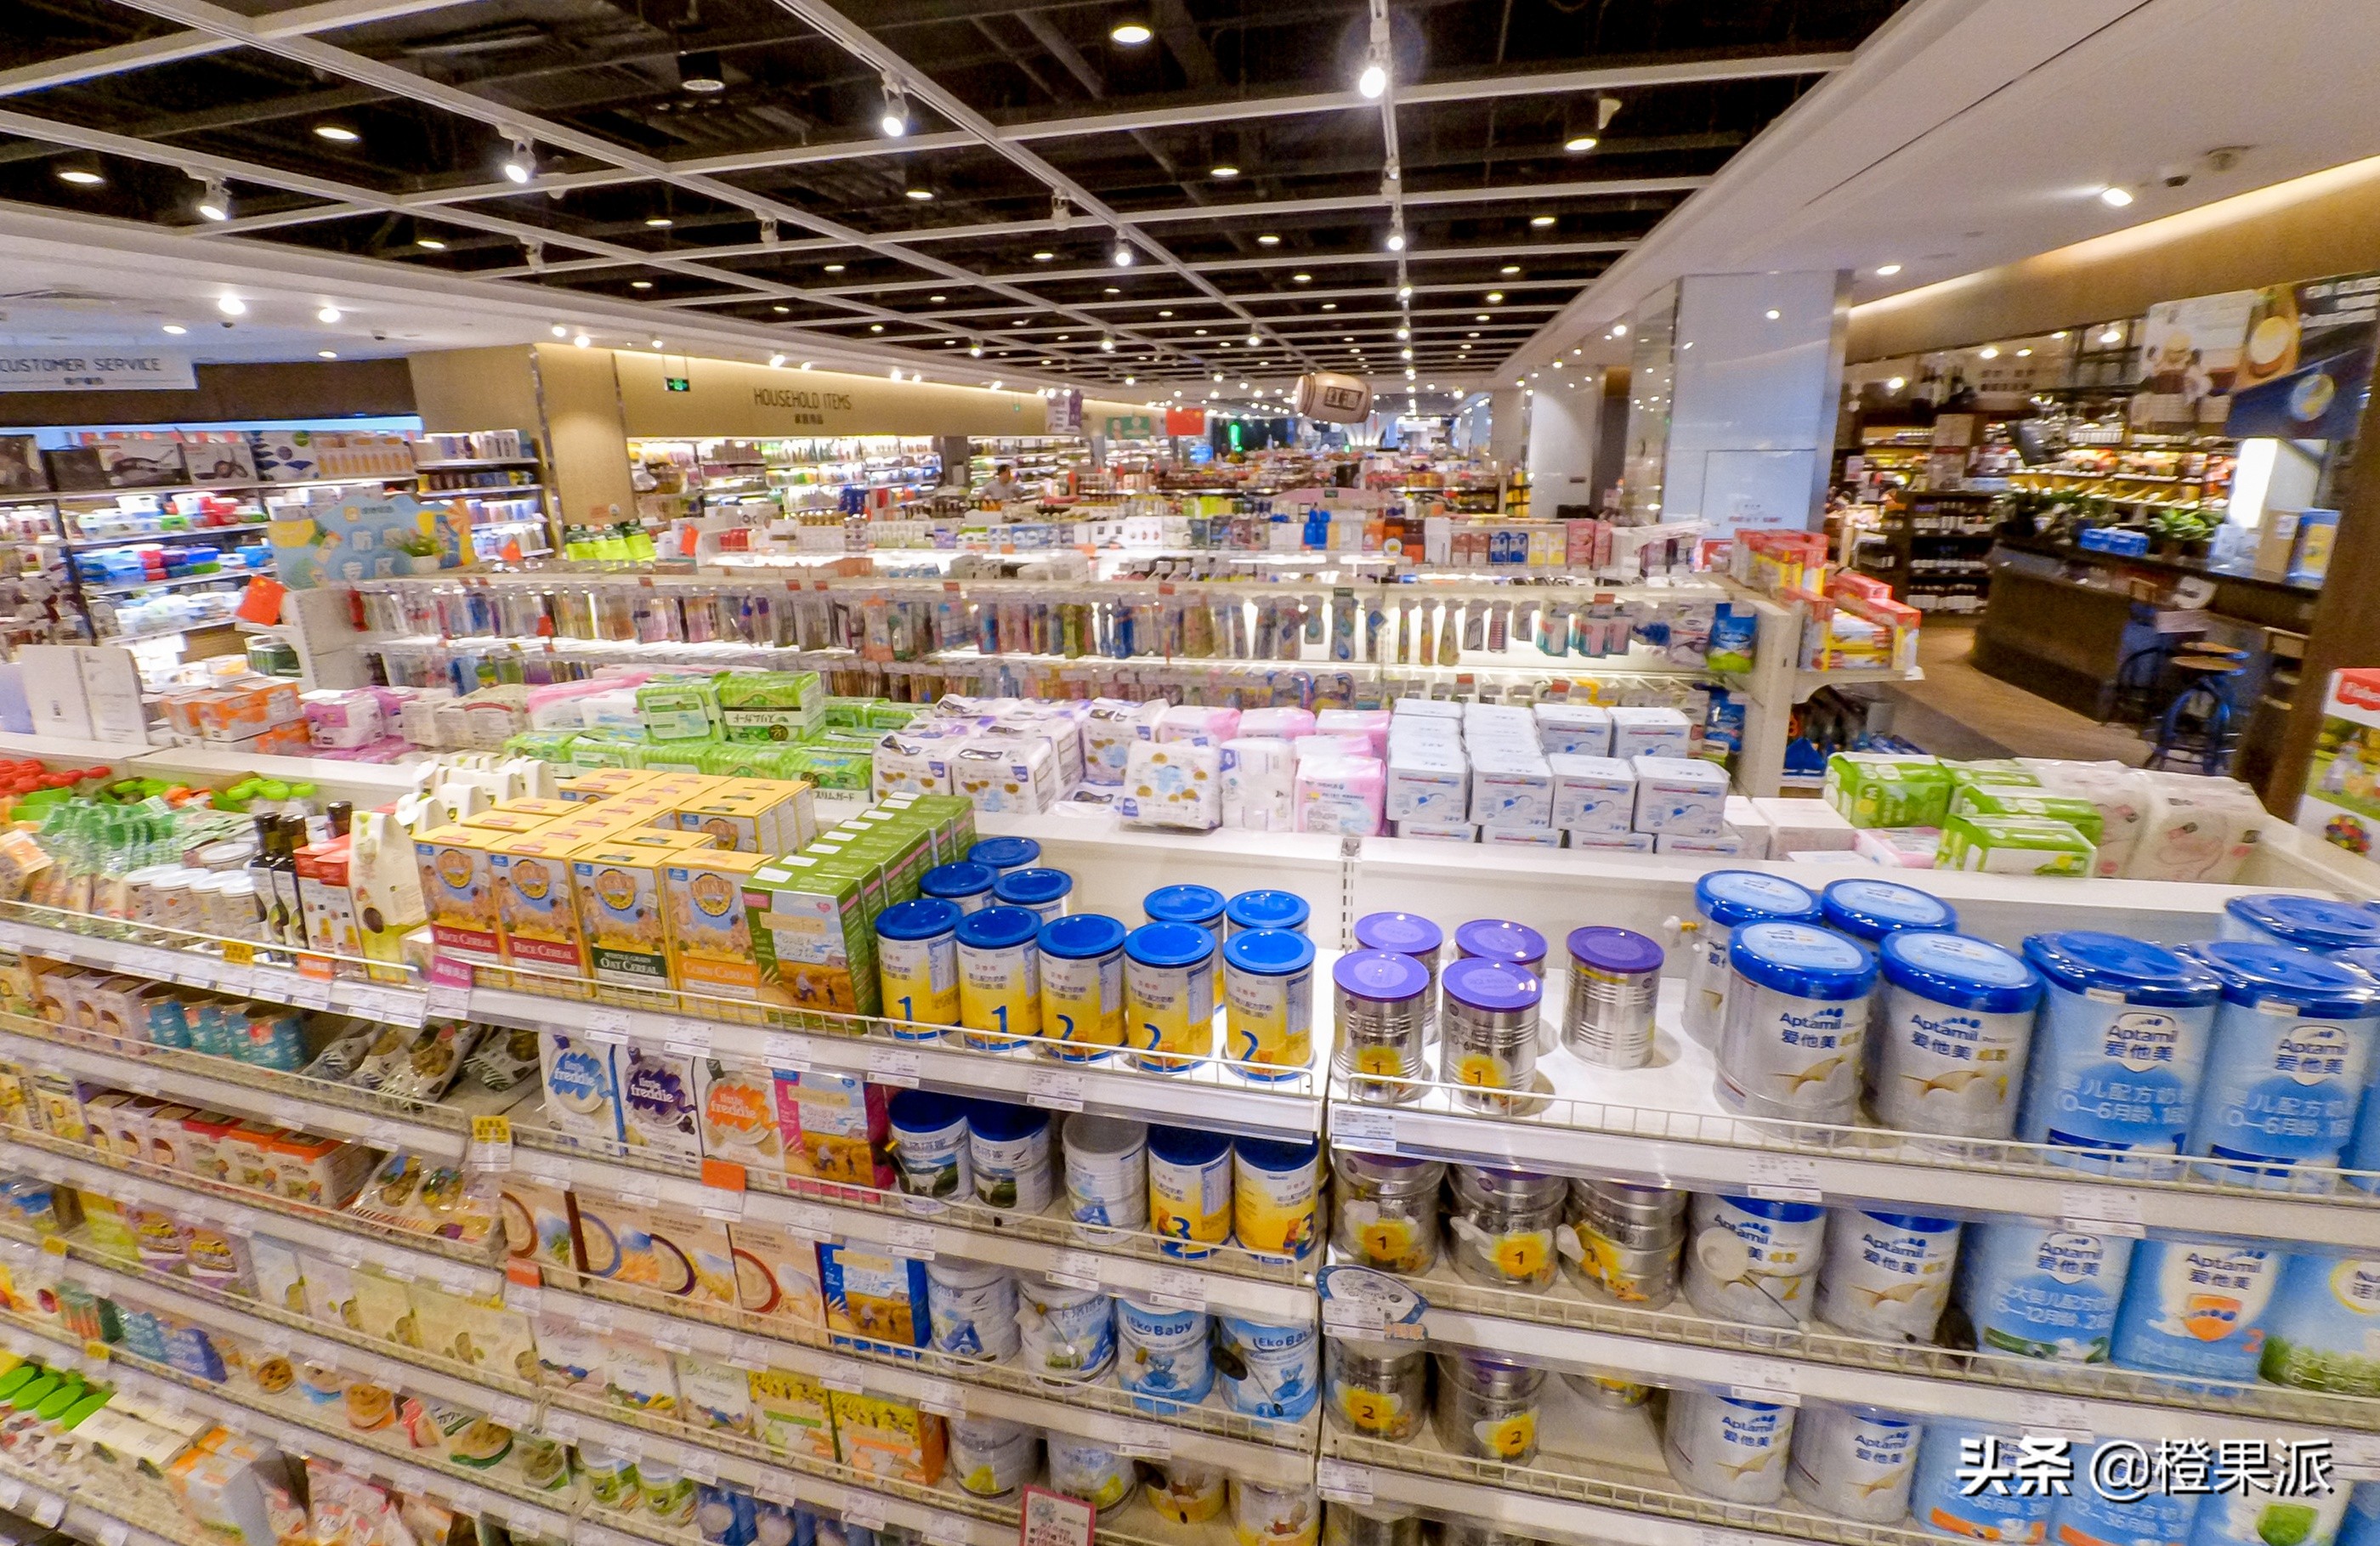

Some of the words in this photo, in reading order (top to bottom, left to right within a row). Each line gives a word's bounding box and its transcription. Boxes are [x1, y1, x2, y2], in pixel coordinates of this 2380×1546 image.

[0, 358, 87, 371] CUSTOMER
[93, 358, 162, 371] SERVICE
[753, 388, 819, 409] HOUSEHOLD
[823, 392, 852, 411] ITEMS
[513, 941, 536, 954] RICE
[538, 943, 574, 960] CEREAL
[599, 958, 620, 971] OAT
[622, 960, 660, 976] CEREAL
[898, 996, 913, 1028] 1
[991, 1005, 1007, 1033] 1
[1780, 1011, 1843, 1030] Aptamil
[1056, 1014, 1075, 1049] 2
[1911, 1014, 1979, 1041] Aptamil
[2108, 1025, 2179, 1043] Aptamil
[1143, 1022, 1162, 1057] 2
[1240, 1029, 1260, 1066] 2
[1781, 1028, 1837, 1050] 爱他美
[1911, 1030, 1972, 1061] 爱他美
[2279, 1038, 2349, 1056] Aptamil
[2105, 1039, 2174, 1062] 爱他美
[1372, 1061, 1381, 1074] 1
[2275, 1053, 2346, 1075] 爱他美
[553, 1067, 597, 1087] freddie
[1473, 1070, 1482, 1084] 1
[630, 1084, 675, 1103] freddie
[711, 1100, 758, 1119] freddie
[1167, 1216, 1193, 1250] 3
[1378, 1236, 1388, 1250] 1
[1862, 1233, 1924, 1259] Aptamil
[2040, 1241, 2103, 1260] Aptamil
[1515, 1251, 1524, 1265] 1
[1863, 1248, 1918, 1275] 爱他美
[2037, 1256, 2101, 1277] 爱他美
[2185, 1252, 2262, 1273] Aptamil
[2187, 1269, 2252, 1291] 爱他美
[2241, 1328, 2265, 1353] 2
[1363, 1405, 1374, 1419] 2
[1721, 1416, 1775, 1432] Aptamil
[1510, 1430, 1522, 1445] 2
[1855, 1434, 1908, 1449] Aptamil
